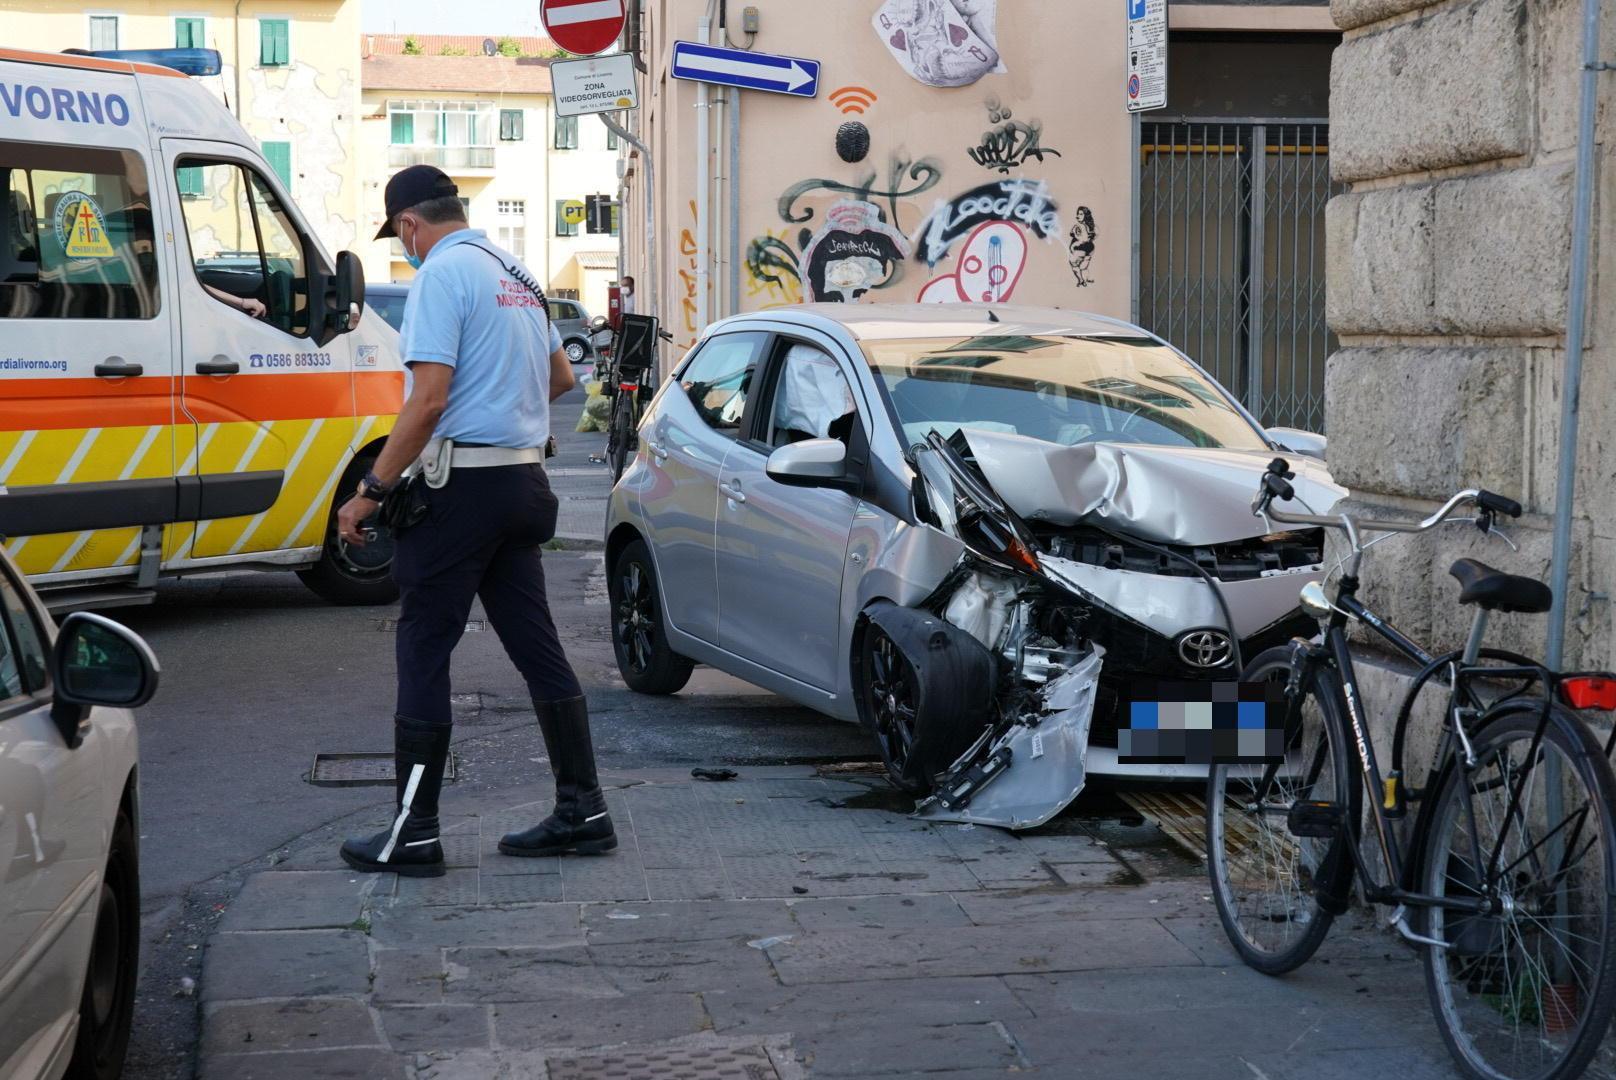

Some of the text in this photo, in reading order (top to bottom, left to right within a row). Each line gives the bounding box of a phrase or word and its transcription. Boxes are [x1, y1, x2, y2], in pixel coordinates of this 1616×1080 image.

[584, 82, 605, 91] ZONA
[560, 89, 632, 103] VIDEOSORVEGLIATA
[0, 83, 129, 126] VORNO
[565, 206, 583, 217] PT
[0, 358, 67, 371] rdialivorno.org
[266, 352, 331, 367] 0586 883333
